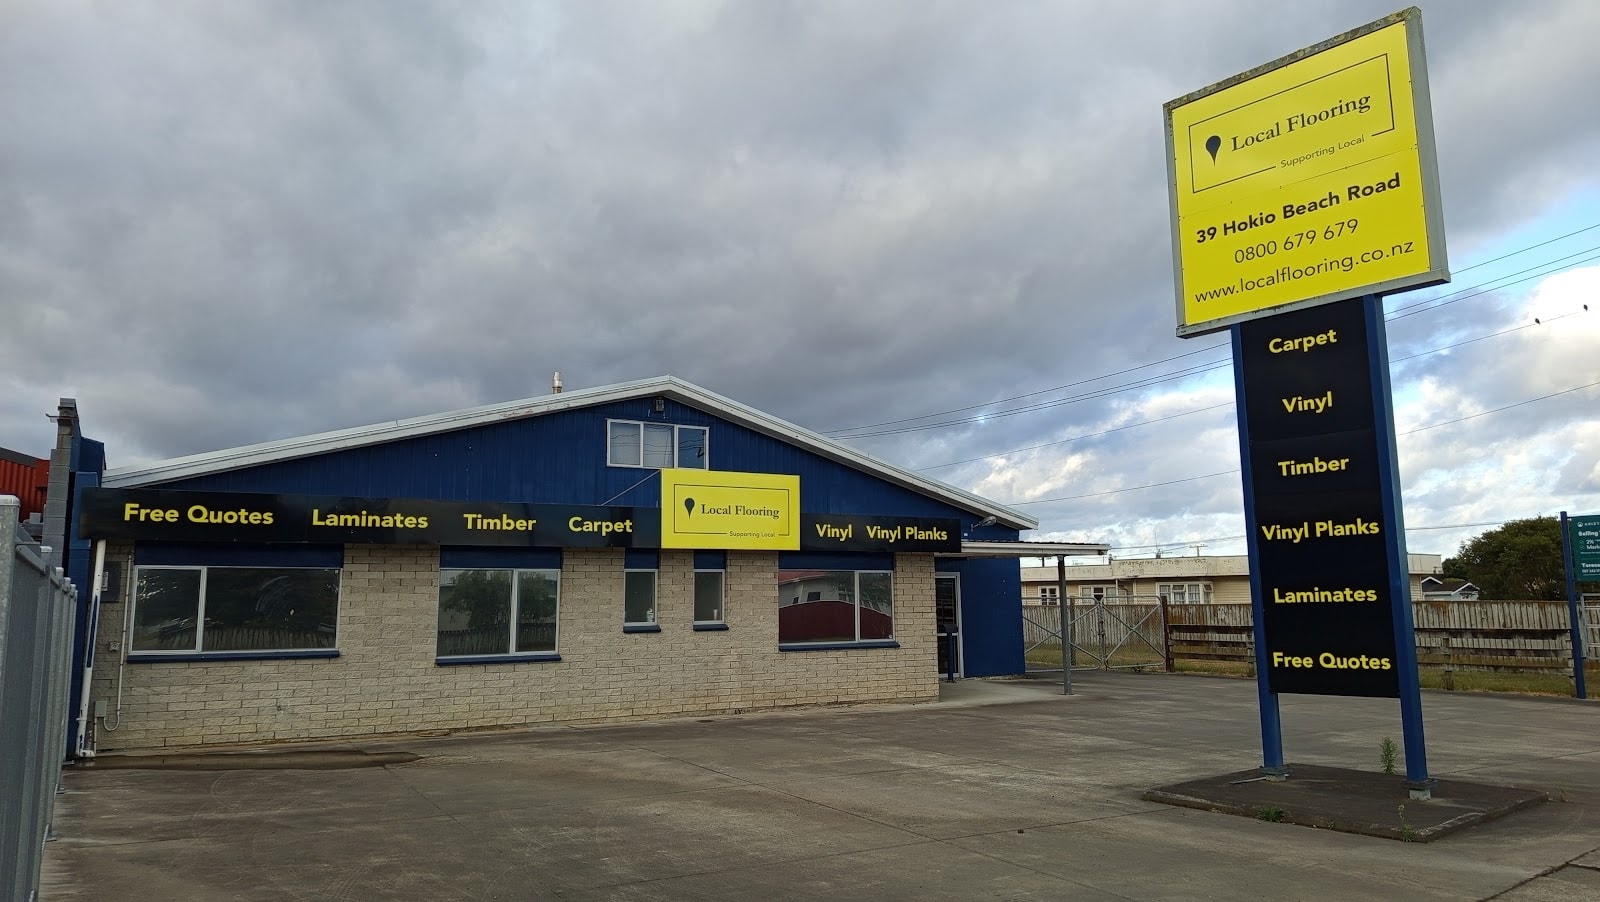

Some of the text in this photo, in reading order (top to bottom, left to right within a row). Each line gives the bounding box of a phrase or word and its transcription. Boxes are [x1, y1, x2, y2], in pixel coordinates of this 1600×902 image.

[1231, 96, 1371, 152] Local Flooring
[1280, 134, 1365, 168] Supporting Local
[1196, 172, 1401, 243] 39 Hokio Beach Road
[1234, 218, 1359, 263] 0800 679 679
[1195, 241, 1415, 303] www.localflooring.co.nz
[1268, 329, 1337, 353] Carpet
[1282, 391, 1333, 414] Vinyl
[1278, 457, 1350, 477] Timber
[124, 502, 274, 525] Free Quotes
[312, 509, 429, 529] Laminates
[701, 504, 780, 519] Local Flooring
[463, 513, 536, 532] Timber
[568, 516, 632, 536] Carpet
[816, 524, 853, 542] Vinyl
[1262, 518, 1380, 543] Vinyl Planks
[866, 526, 948, 543] Vinyl Planks
[1273, 587, 1377, 605] Laminates
[1272, 651, 1391, 671] Free Quotes
